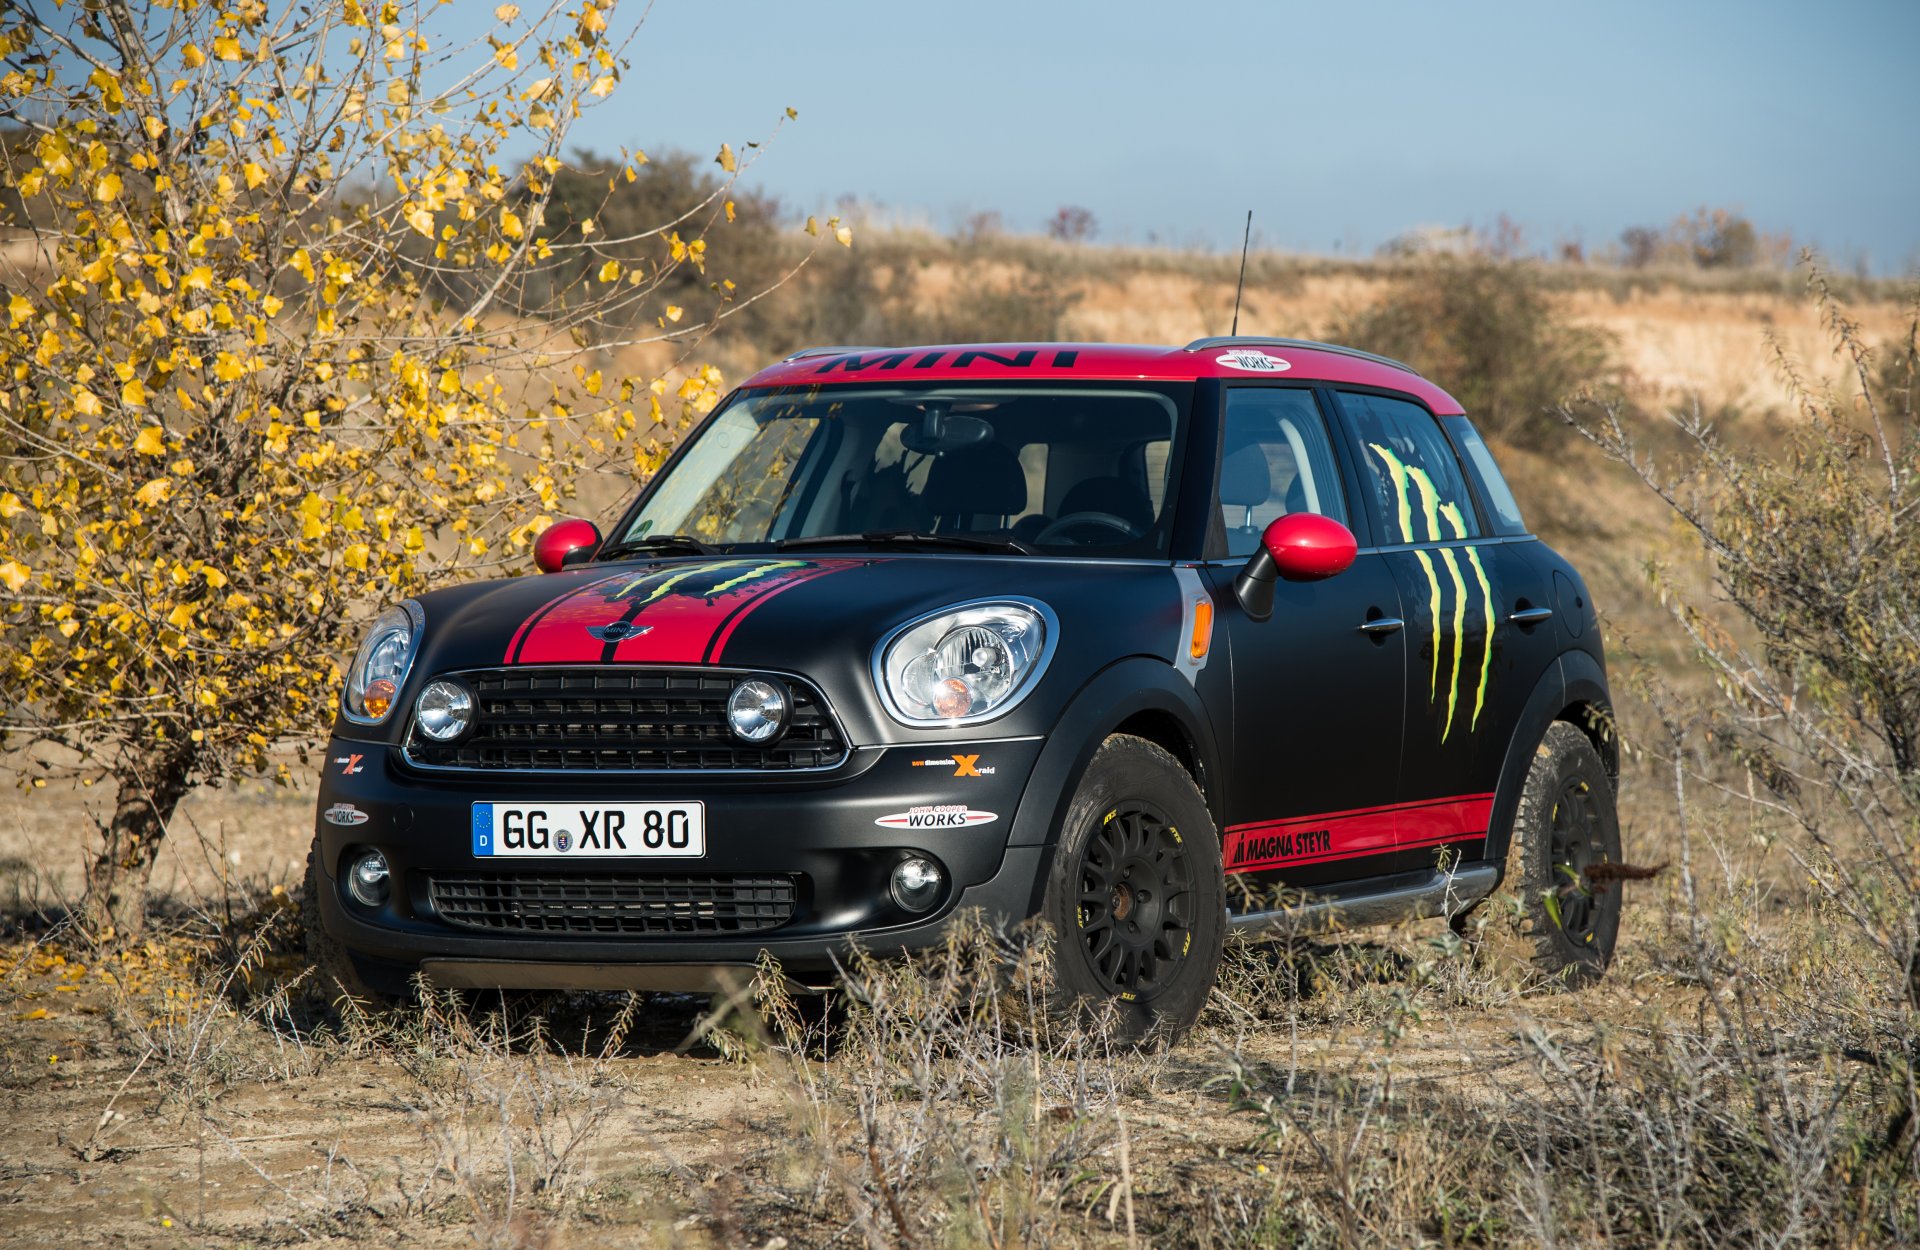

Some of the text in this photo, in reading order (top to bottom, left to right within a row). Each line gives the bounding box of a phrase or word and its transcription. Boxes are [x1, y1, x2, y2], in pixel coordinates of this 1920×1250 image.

[816, 351, 1079, 373] MINI
[1235, 355, 1274, 369] WORKS
[333, 810, 355, 823] WORKS
[909, 805, 967, 814] JOHN COOPER
[908, 813, 967, 827] WORKS
[503, 810, 689, 849] GG XR 80
[480, 835, 488, 846] D
[1246, 830, 1331, 861] MAGNA STEYR
